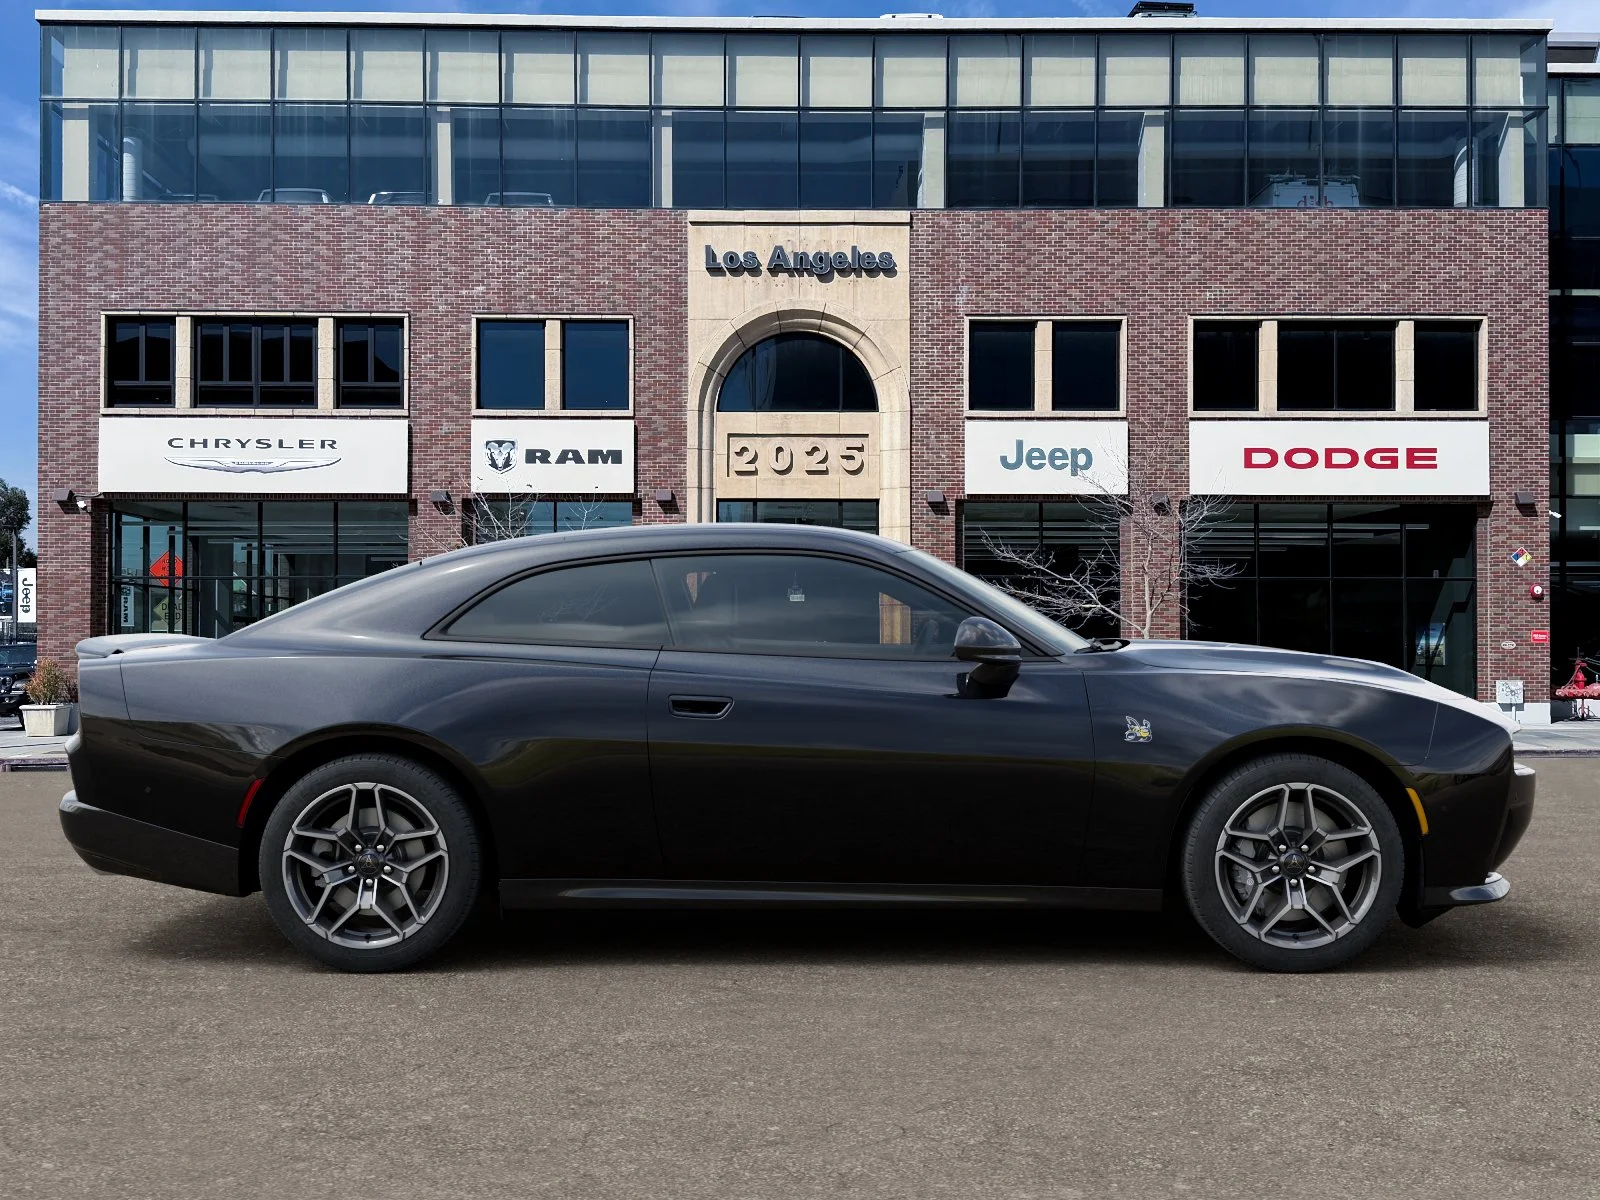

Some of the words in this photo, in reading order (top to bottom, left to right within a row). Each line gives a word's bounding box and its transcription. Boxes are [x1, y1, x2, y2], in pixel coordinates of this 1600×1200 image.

[704, 244, 758, 269] Los
[767, 245, 895, 275] Angeles
[167, 437, 338, 450] CHRYSLER
[525, 448, 623, 465] RAM
[734, 440, 866, 477] 2025
[999, 439, 1094, 476] Jeep
[1243, 447, 1438, 470] DODGE
[19, 577, 34, 614] Jeep
[164, 612, 181, 620] ED
